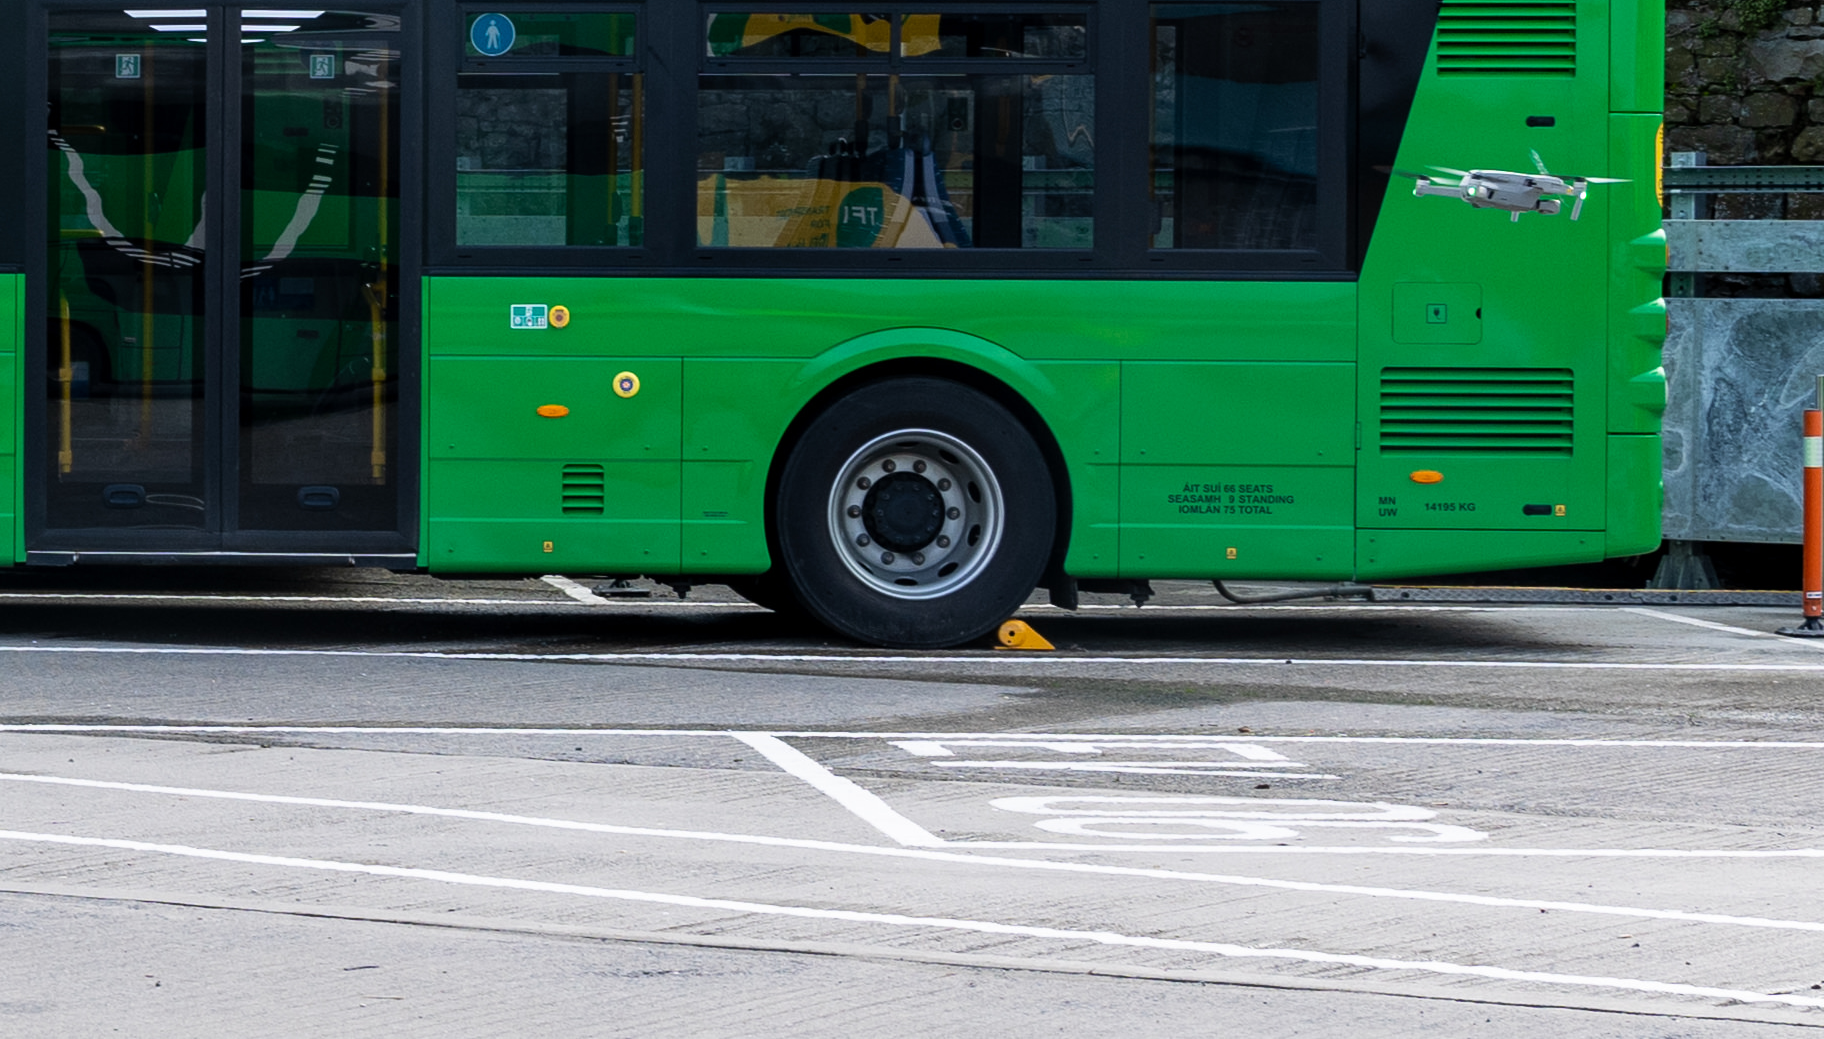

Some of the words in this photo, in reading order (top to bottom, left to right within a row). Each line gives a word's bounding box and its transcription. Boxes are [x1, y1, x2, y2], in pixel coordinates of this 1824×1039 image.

[1183, 482, 1201, 493] ÁIT
[1224, 484, 1236, 493] 66
[1239, 485, 1273, 493] SEATS
[1168, 495, 1221, 503] SEASAMH
[1229, 495, 1235, 503] 9
[1239, 495, 1294, 504] STANDING
[1379, 497, 1395, 505] MN
[1179, 505, 1220, 514] IOMLÁN
[1224, 506, 1235, 514] 75
[1238, 506, 1272, 514] TOTAL
[1425, 503, 1455, 511] 14195
[1459, 503, 1475, 511] KG
[1379, 508, 1397, 516] UW
